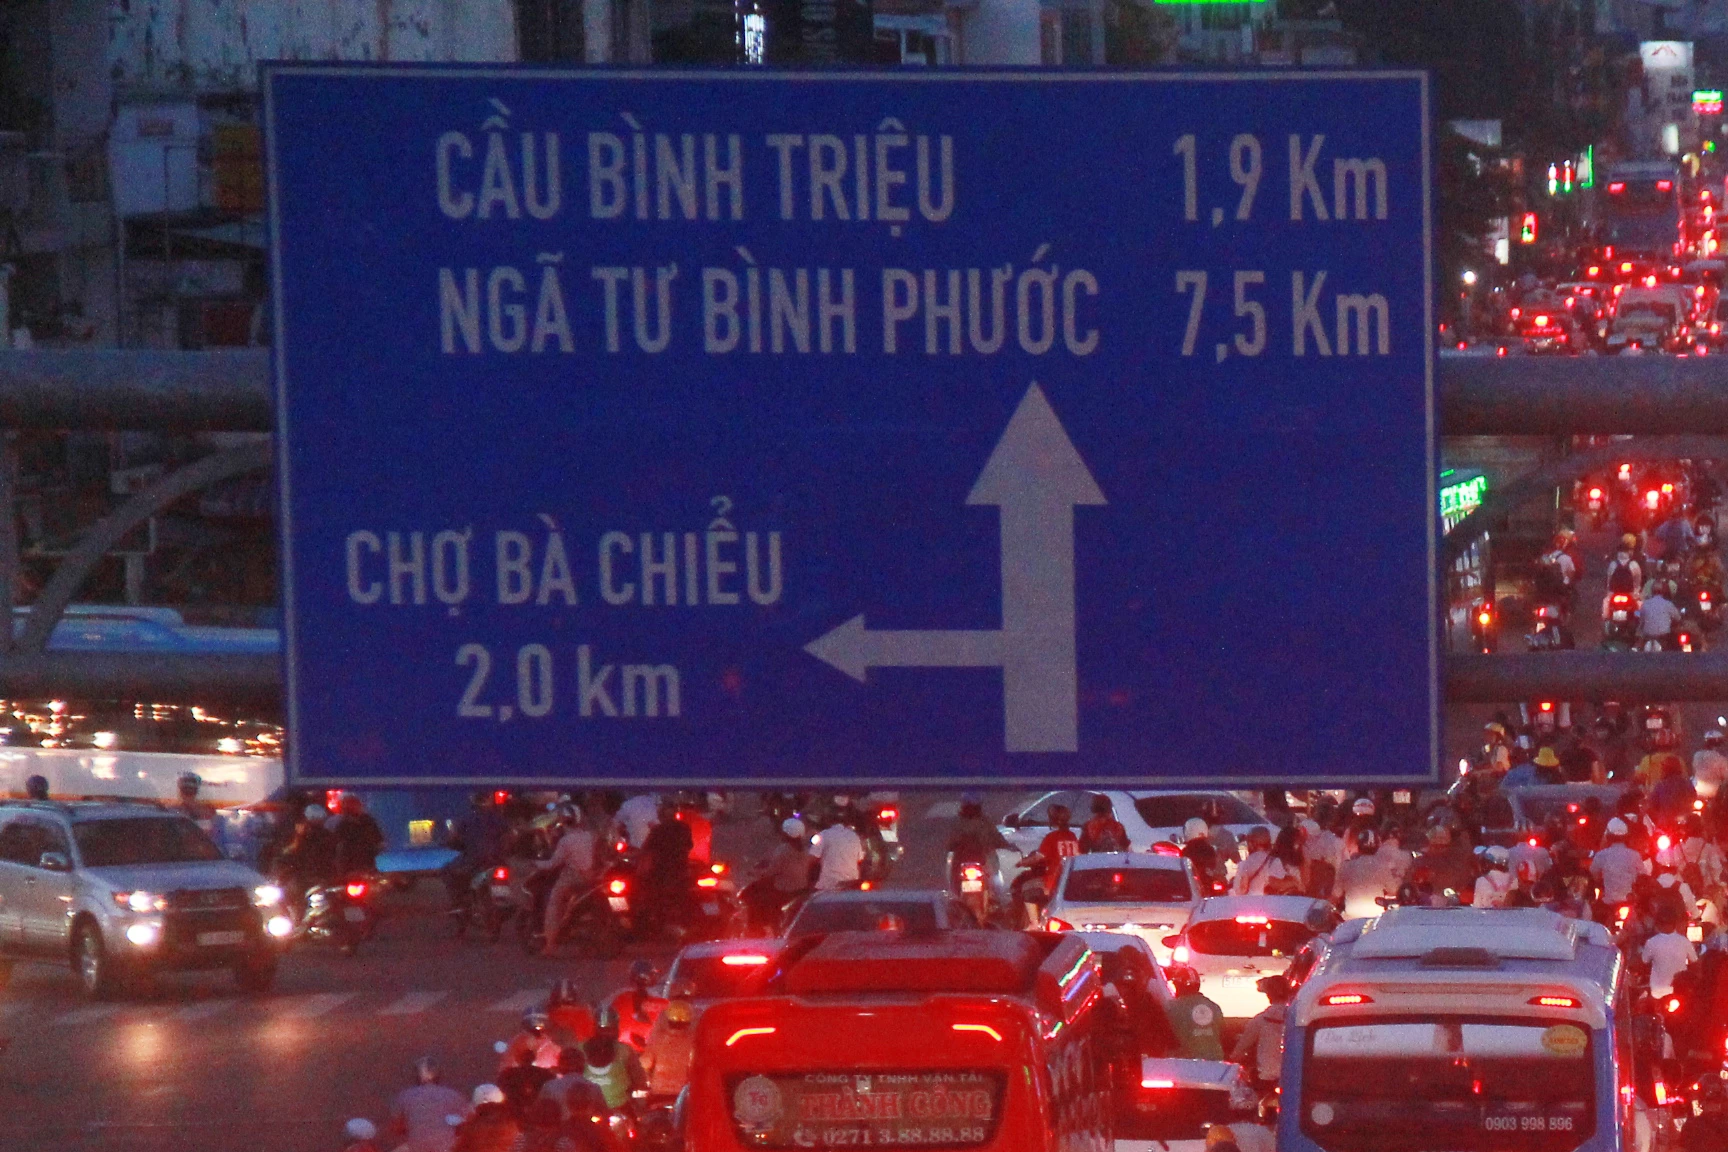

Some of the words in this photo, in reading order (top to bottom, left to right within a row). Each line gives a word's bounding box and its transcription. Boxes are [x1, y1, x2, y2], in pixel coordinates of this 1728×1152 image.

[436, 98, 561, 221] CẦU
[588, 113, 743, 221] BÌNH
[766, 117, 955, 236] TRIỆU
[1173, 133, 1262, 227] 1,9
[1288, 133, 1388, 221] Km
[439, 252, 575, 354] NGÃ
[592, 262, 678, 354] TƯ
[702, 246, 857, 354] BÌNH
[882, 243, 1100, 355] PHƯỚC
[1175, 270, 1266, 362] 7,5
[1292, 271, 1391, 356] Km
[346, 528, 472, 615] CHỢ
[495, 514, 578, 606] BÀ
[599, 495, 782, 606] CHIỂU
[455, 643, 553, 721] 2,0
[577, 644, 681, 717] km
[823, 1128, 871, 1145] 0271
[1485, 1116, 1517, 1131] 0903
[1521, 1116, 1545, 1131] 998
